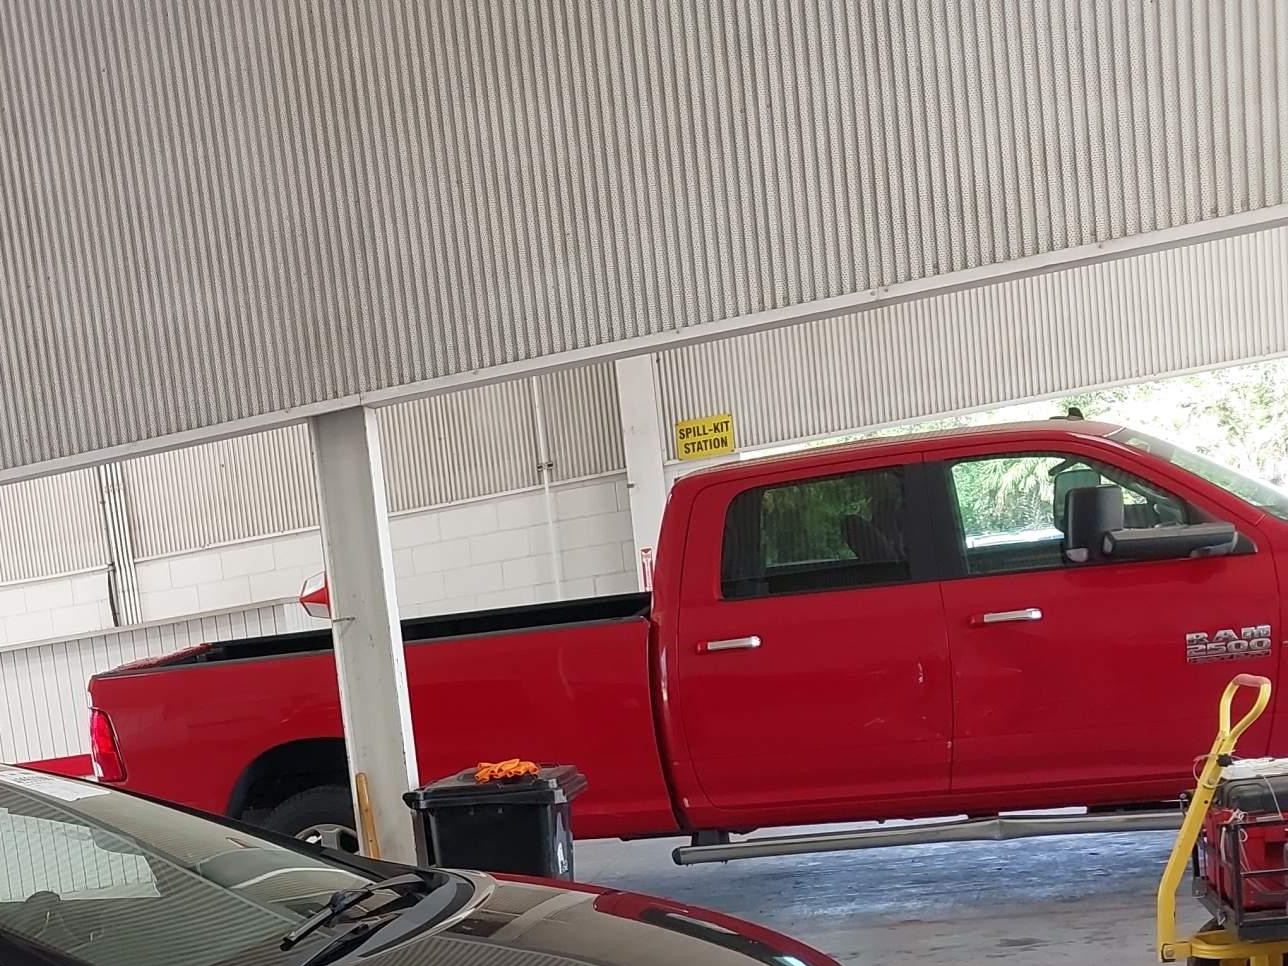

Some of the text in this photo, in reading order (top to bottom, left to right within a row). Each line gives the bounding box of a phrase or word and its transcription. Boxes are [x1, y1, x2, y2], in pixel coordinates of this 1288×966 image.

[678, 420, 730, 440] SPILL-KIT
[684, 436, 728, 454] STATION
[1186, 625, 1271, 645] RAM
[1187, 638, 1271, 656] 2500
